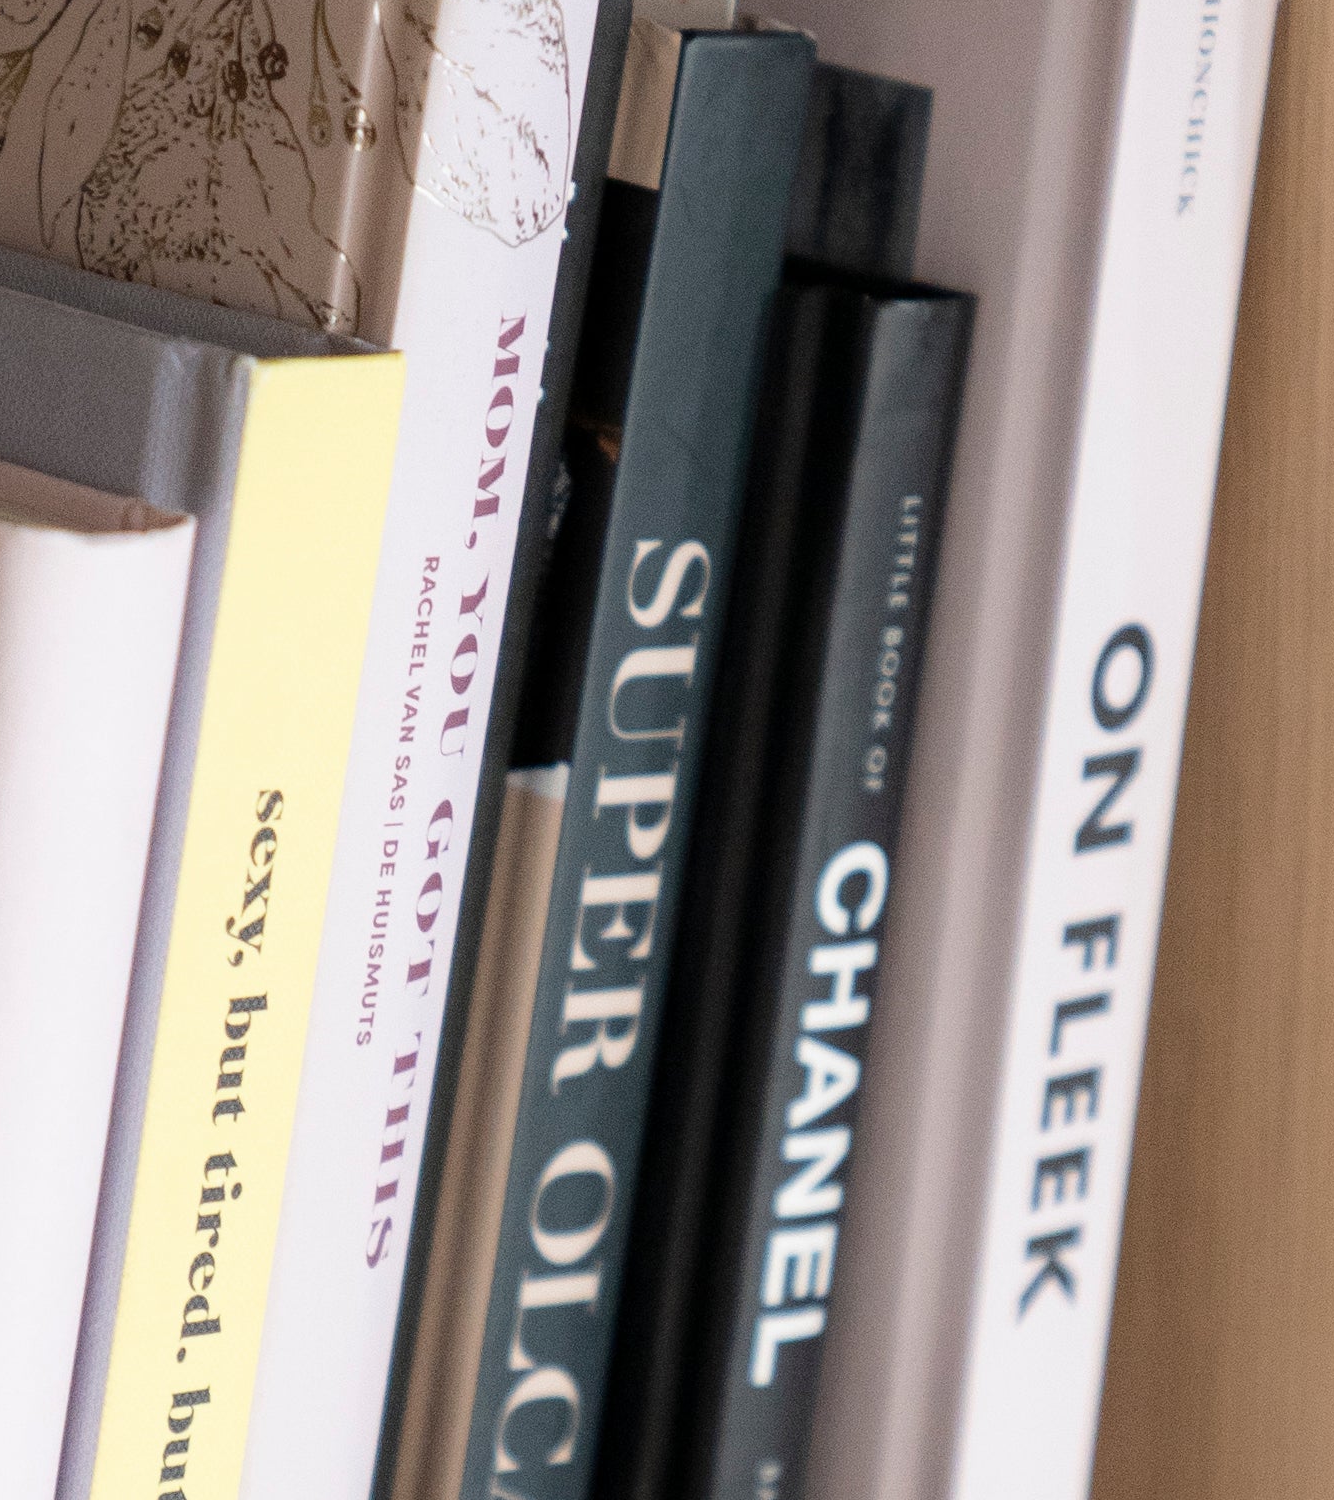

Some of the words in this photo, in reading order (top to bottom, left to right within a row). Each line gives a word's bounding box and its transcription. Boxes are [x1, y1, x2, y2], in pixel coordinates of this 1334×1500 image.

[461, 308, 529, 552] MOM,
[407, 554, 440, 678] RACHEL
[888, 494, 922, 610] LITTLE
[399, 684, 424, 743] VAN
[435, 571, 493, 763] YOU
[872, 625, 905, 732] BOOK
[1069, 618, 1156, 857] ON
[224, 785, 287, 968] sexy,
[378, 839, 399, 878] DE
[388, 754, 411, 812] SAS
[551, 536, 713, 1096] SUPER
[355, 886, 392, 1047] HUISMUTS
[403, 798, 456, 1002] GOT
[210, 991, 271, 1127] but
[363, 1028, 425, 1270] THIS
[747, 838, 890, 1389] CHANEL
[1015, 908, 1122, 1325] FLEEK
[173, 1146, 246, 1365] tired.
